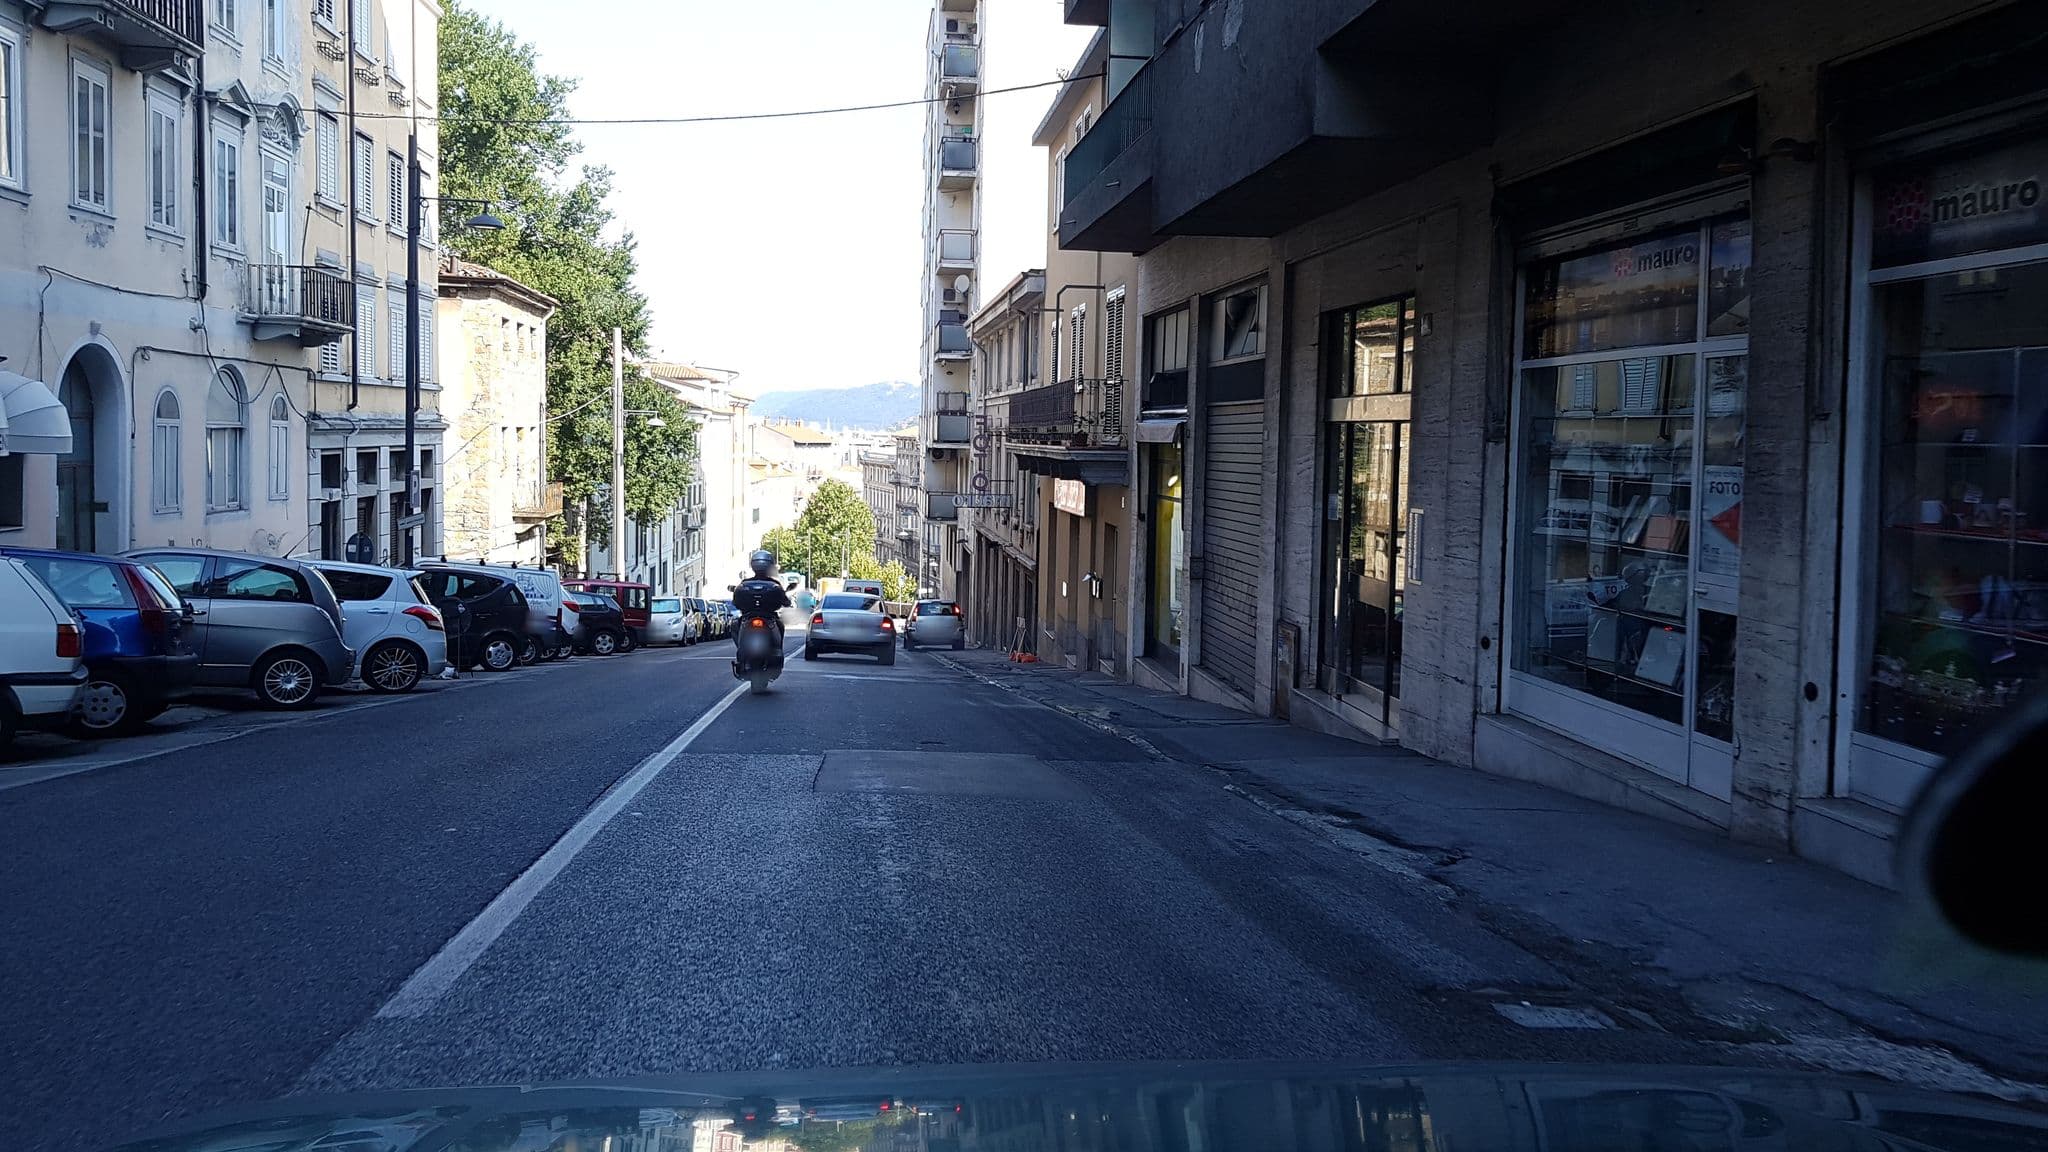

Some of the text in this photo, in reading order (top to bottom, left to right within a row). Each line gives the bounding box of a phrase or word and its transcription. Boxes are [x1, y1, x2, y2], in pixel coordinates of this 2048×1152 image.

[1932, 178, 2041, 223] mauro
[1636, 244, 1697, 273] mauro
[1709, 481, 1741, 495] FOTO
